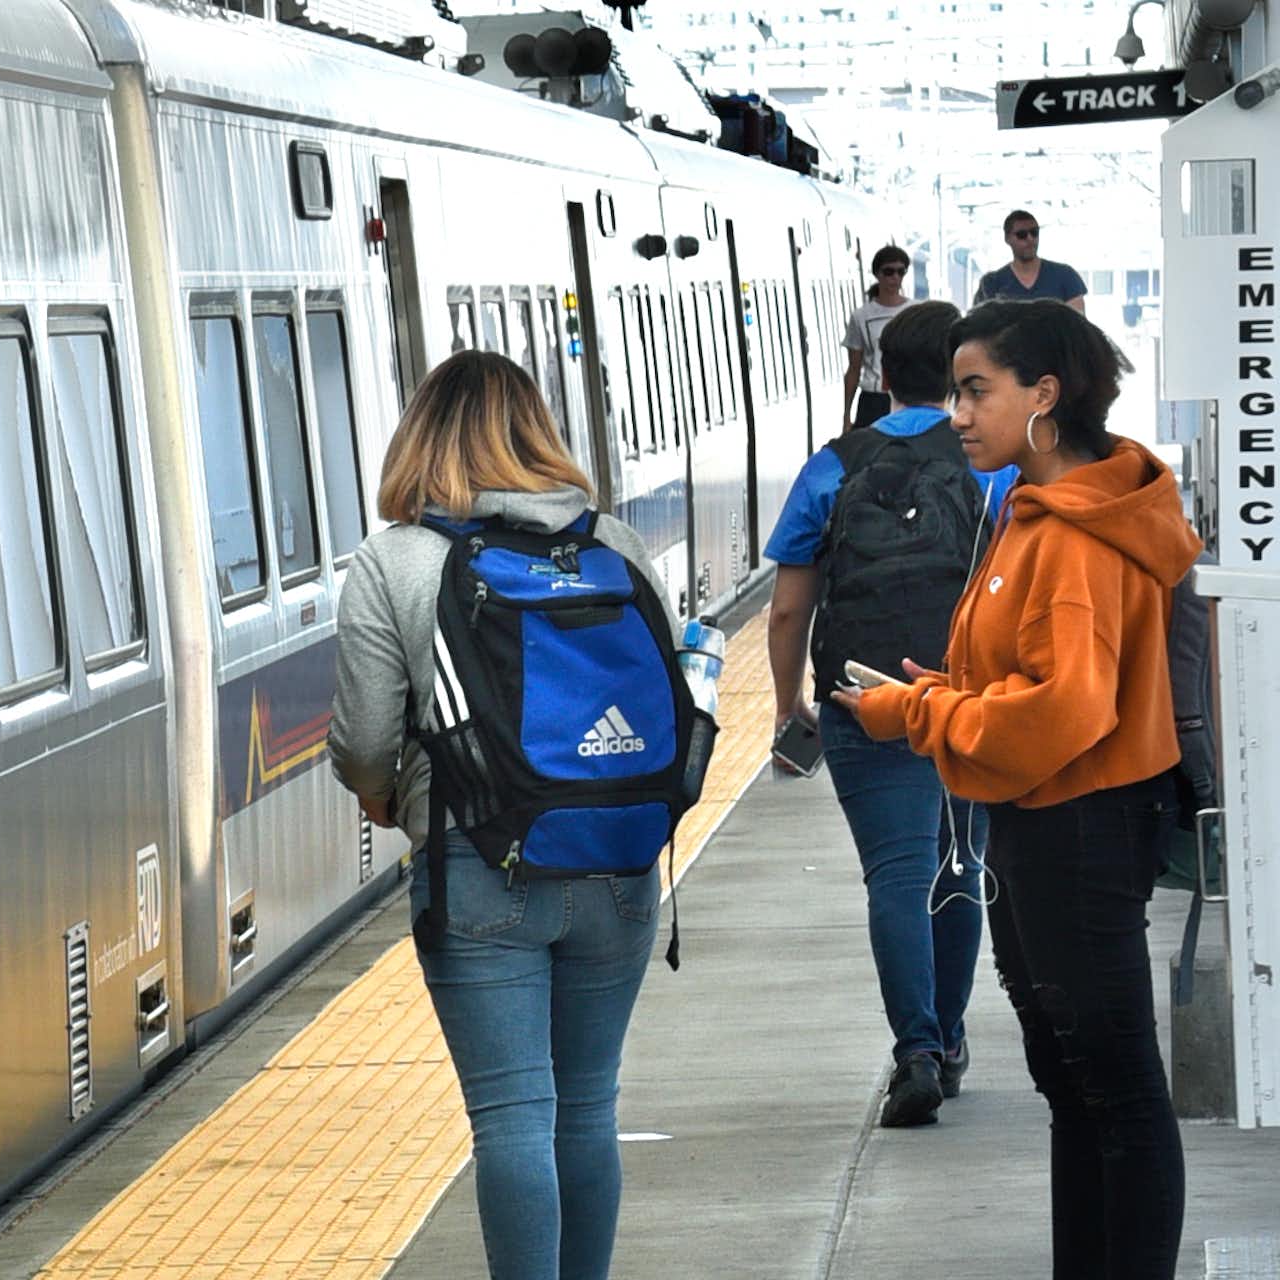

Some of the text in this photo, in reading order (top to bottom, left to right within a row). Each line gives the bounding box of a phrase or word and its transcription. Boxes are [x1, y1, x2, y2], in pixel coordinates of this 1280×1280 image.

[1062, 84, 1157, 111] TRACK
[1238, 247, 1275, 561] EMERGENCY
[577, 736, 646, 757] adidas
